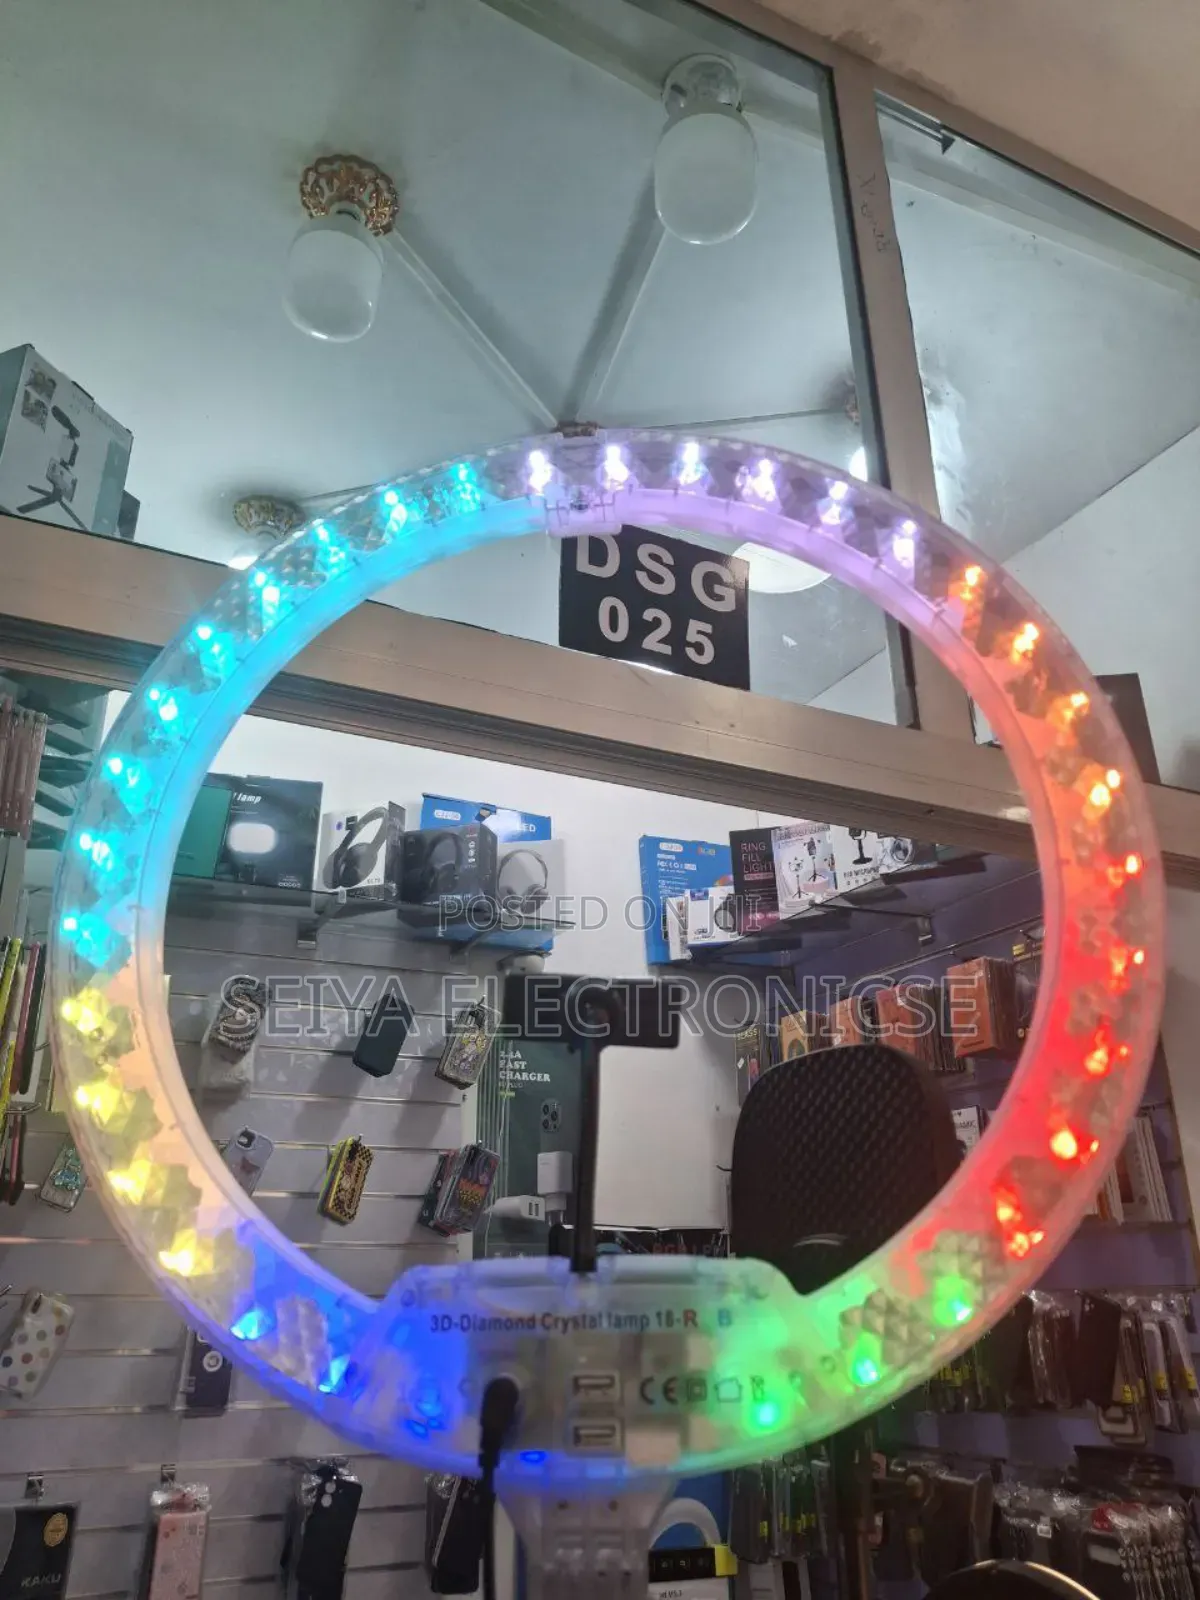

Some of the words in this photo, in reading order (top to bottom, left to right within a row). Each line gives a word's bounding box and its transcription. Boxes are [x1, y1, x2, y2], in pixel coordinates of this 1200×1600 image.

[576, 535, 736, 612] DSG
[598, 596, 715, 665] 025
[236, 793, 262, 804] lamp
[741, 841, 767, 852] RING
[742, 853, 761, 863] FILL
[743, 861, 773, 873] LIGHT
[499, 1071, 551, 1082] CHARGER
[430, 1313, 536, 1333] 3D-Diamond
[541, 1312, 603, 1335] Crystal
[607, 1311, 650, 1332] lamp
